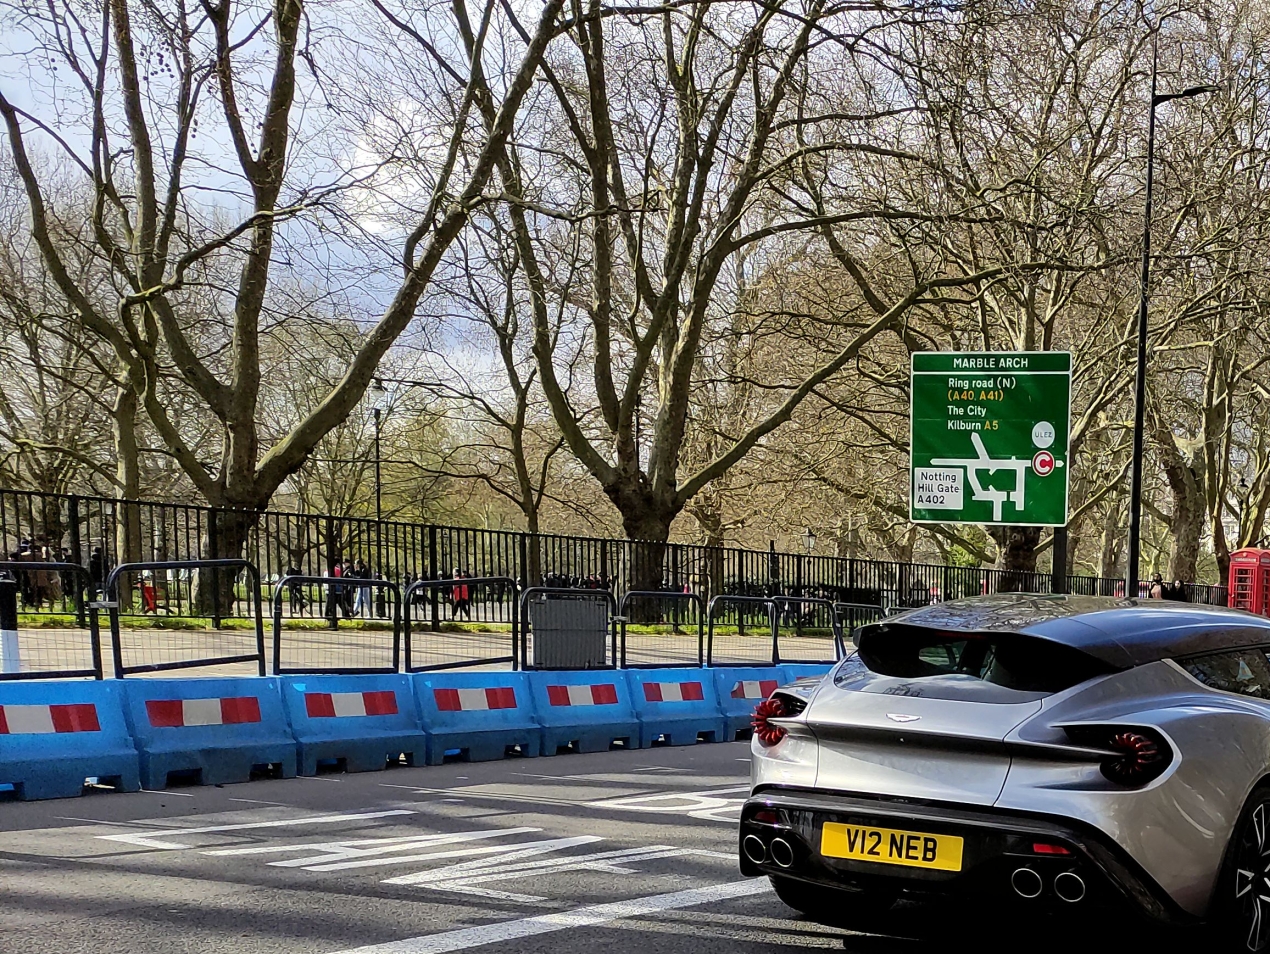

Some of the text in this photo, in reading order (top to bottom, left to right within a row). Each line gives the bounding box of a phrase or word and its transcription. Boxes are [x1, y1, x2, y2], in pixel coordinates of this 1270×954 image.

[953, 357, 1028, 368] MARBLE ARCH
[948, 376, 1016, 390] Ring road (N)
[979, 389, 1004, 402] A41)
[947, 404, 987, 417] The City
[947, 419, 999, 430] Kilburn A5
[920, 471, 957, 483] Notting
[917, 483, 960, 493] Hill Gate
[917, 495, 945, 504] A402
[846, 827, 938, 863] V12 NEB
